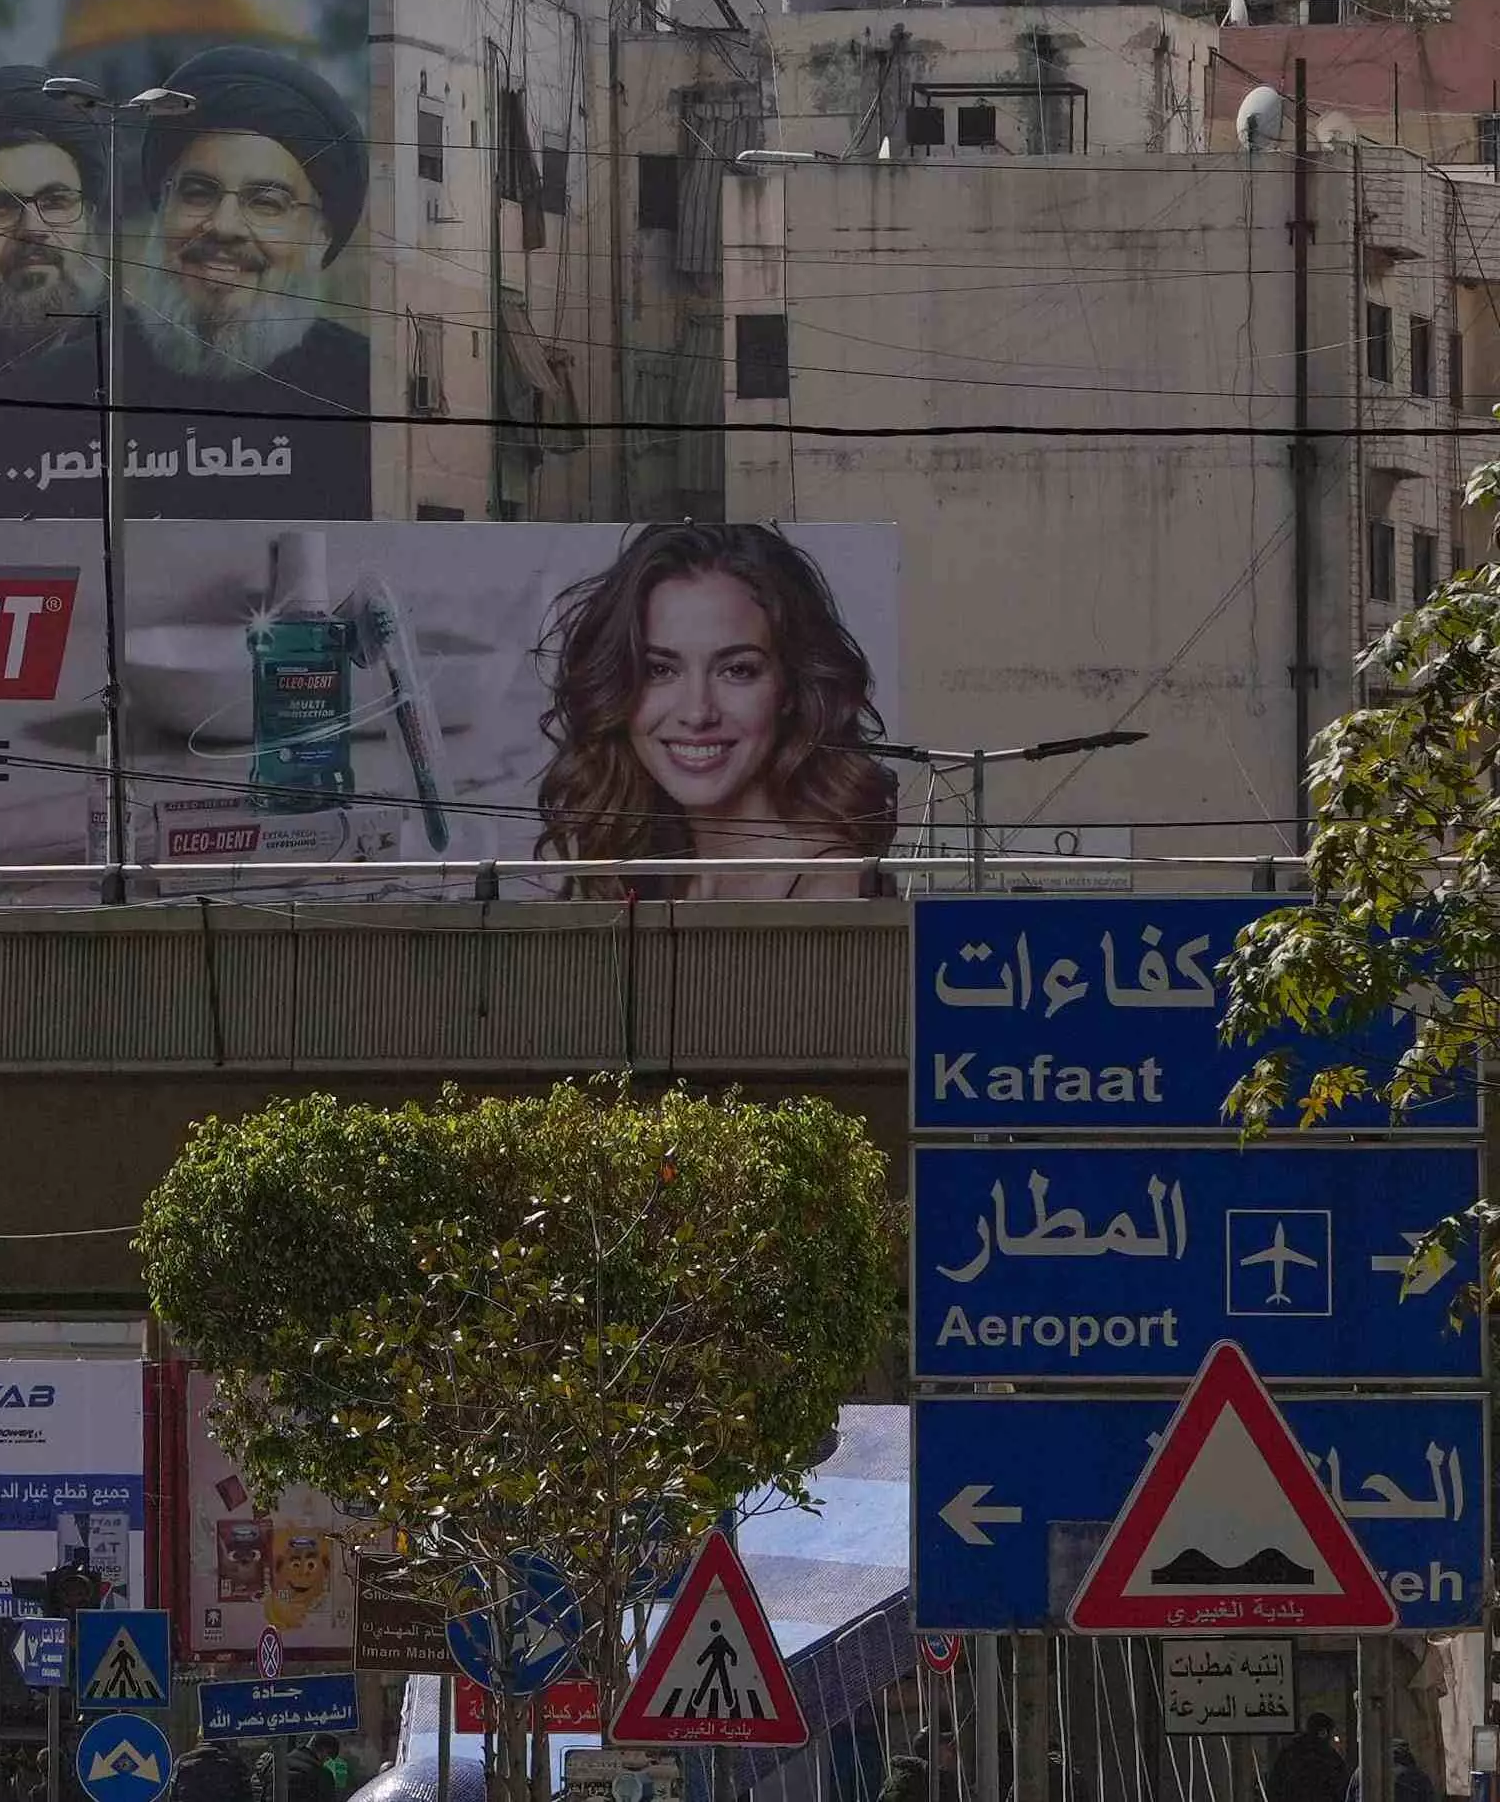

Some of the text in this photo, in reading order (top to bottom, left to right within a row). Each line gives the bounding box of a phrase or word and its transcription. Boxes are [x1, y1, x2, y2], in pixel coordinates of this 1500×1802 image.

[173, 829, 253, 854] CLEO-DENT
[936, 925, 1214, 1019] كفاءات
[934, 1053, 1163, 1102] Kafaat
[936, 1169, 1186, 1282] المطار
[936, 1305, 1178, 1357] Aeroport
[23, 1483, 49, 1503] غيار
[53, 1483, 87, 1505] قطع
[92, 1487, 130, 1505] جميع
[1166, 1597, 1305, 1627] بلدية الغبيري
[362, 1646, 400, 1658] Imam
[1170, 1652, 1233, 1685] مطبات
[252, 1685, 303, 1701] جادة
[1169, 1689, 1289, 1725] خفف السرعة
[208, 1703, 351, 1731] الشهيد هادي نصر الله
[668, 1720, 752, 1740] بلدية الغبيري
